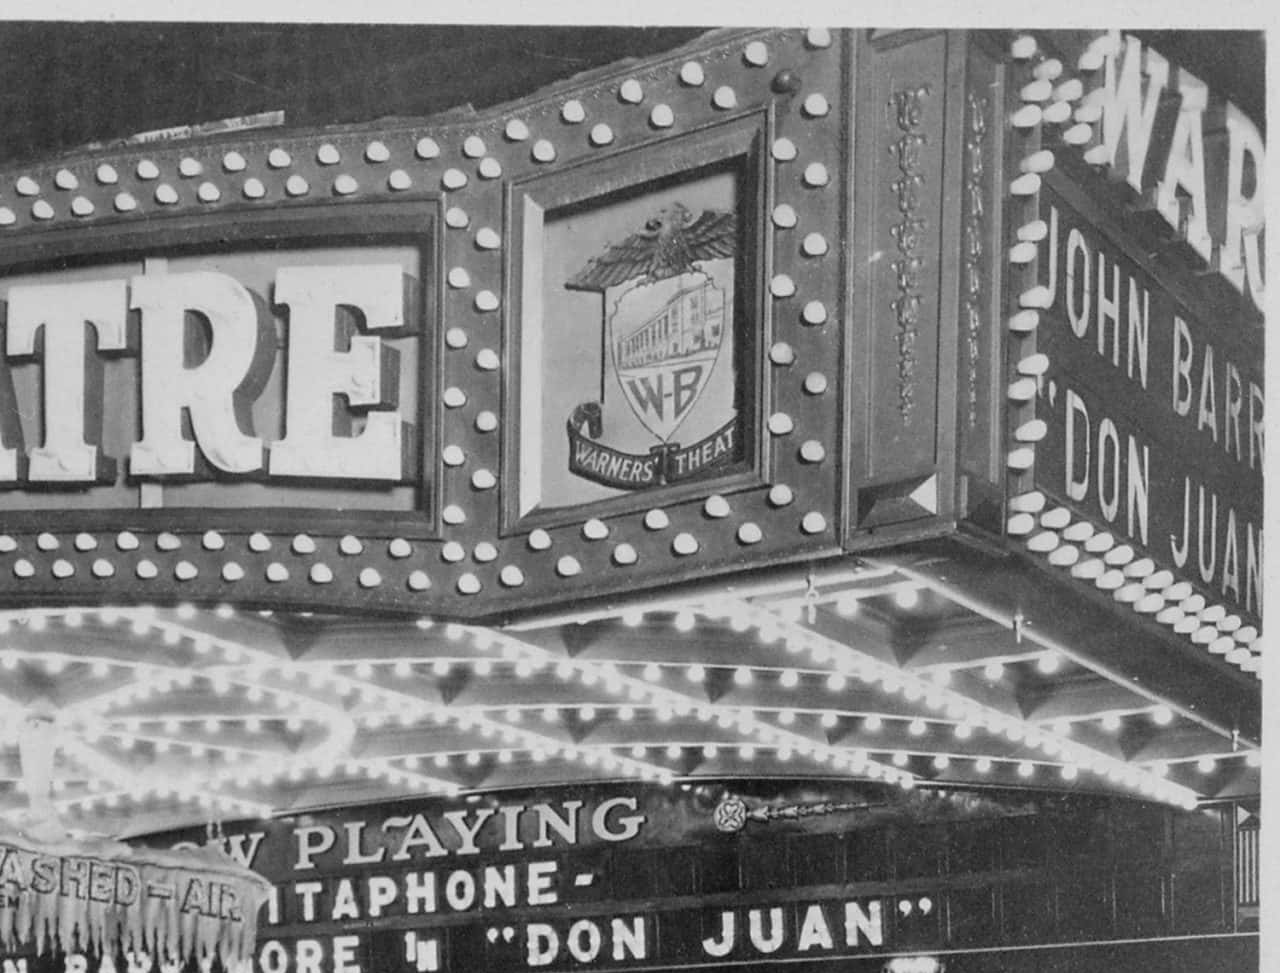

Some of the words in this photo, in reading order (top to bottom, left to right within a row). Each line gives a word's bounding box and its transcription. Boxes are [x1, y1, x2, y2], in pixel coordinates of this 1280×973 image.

[1044, 205, 1150, 390] JOHN
[573, 440, 659, 481] WARNERS'
[675, 426, 735, 474] THEAT
[1169, 476, 1264, 618] JUAN
[292, 796, 646, 871] PLAYING
